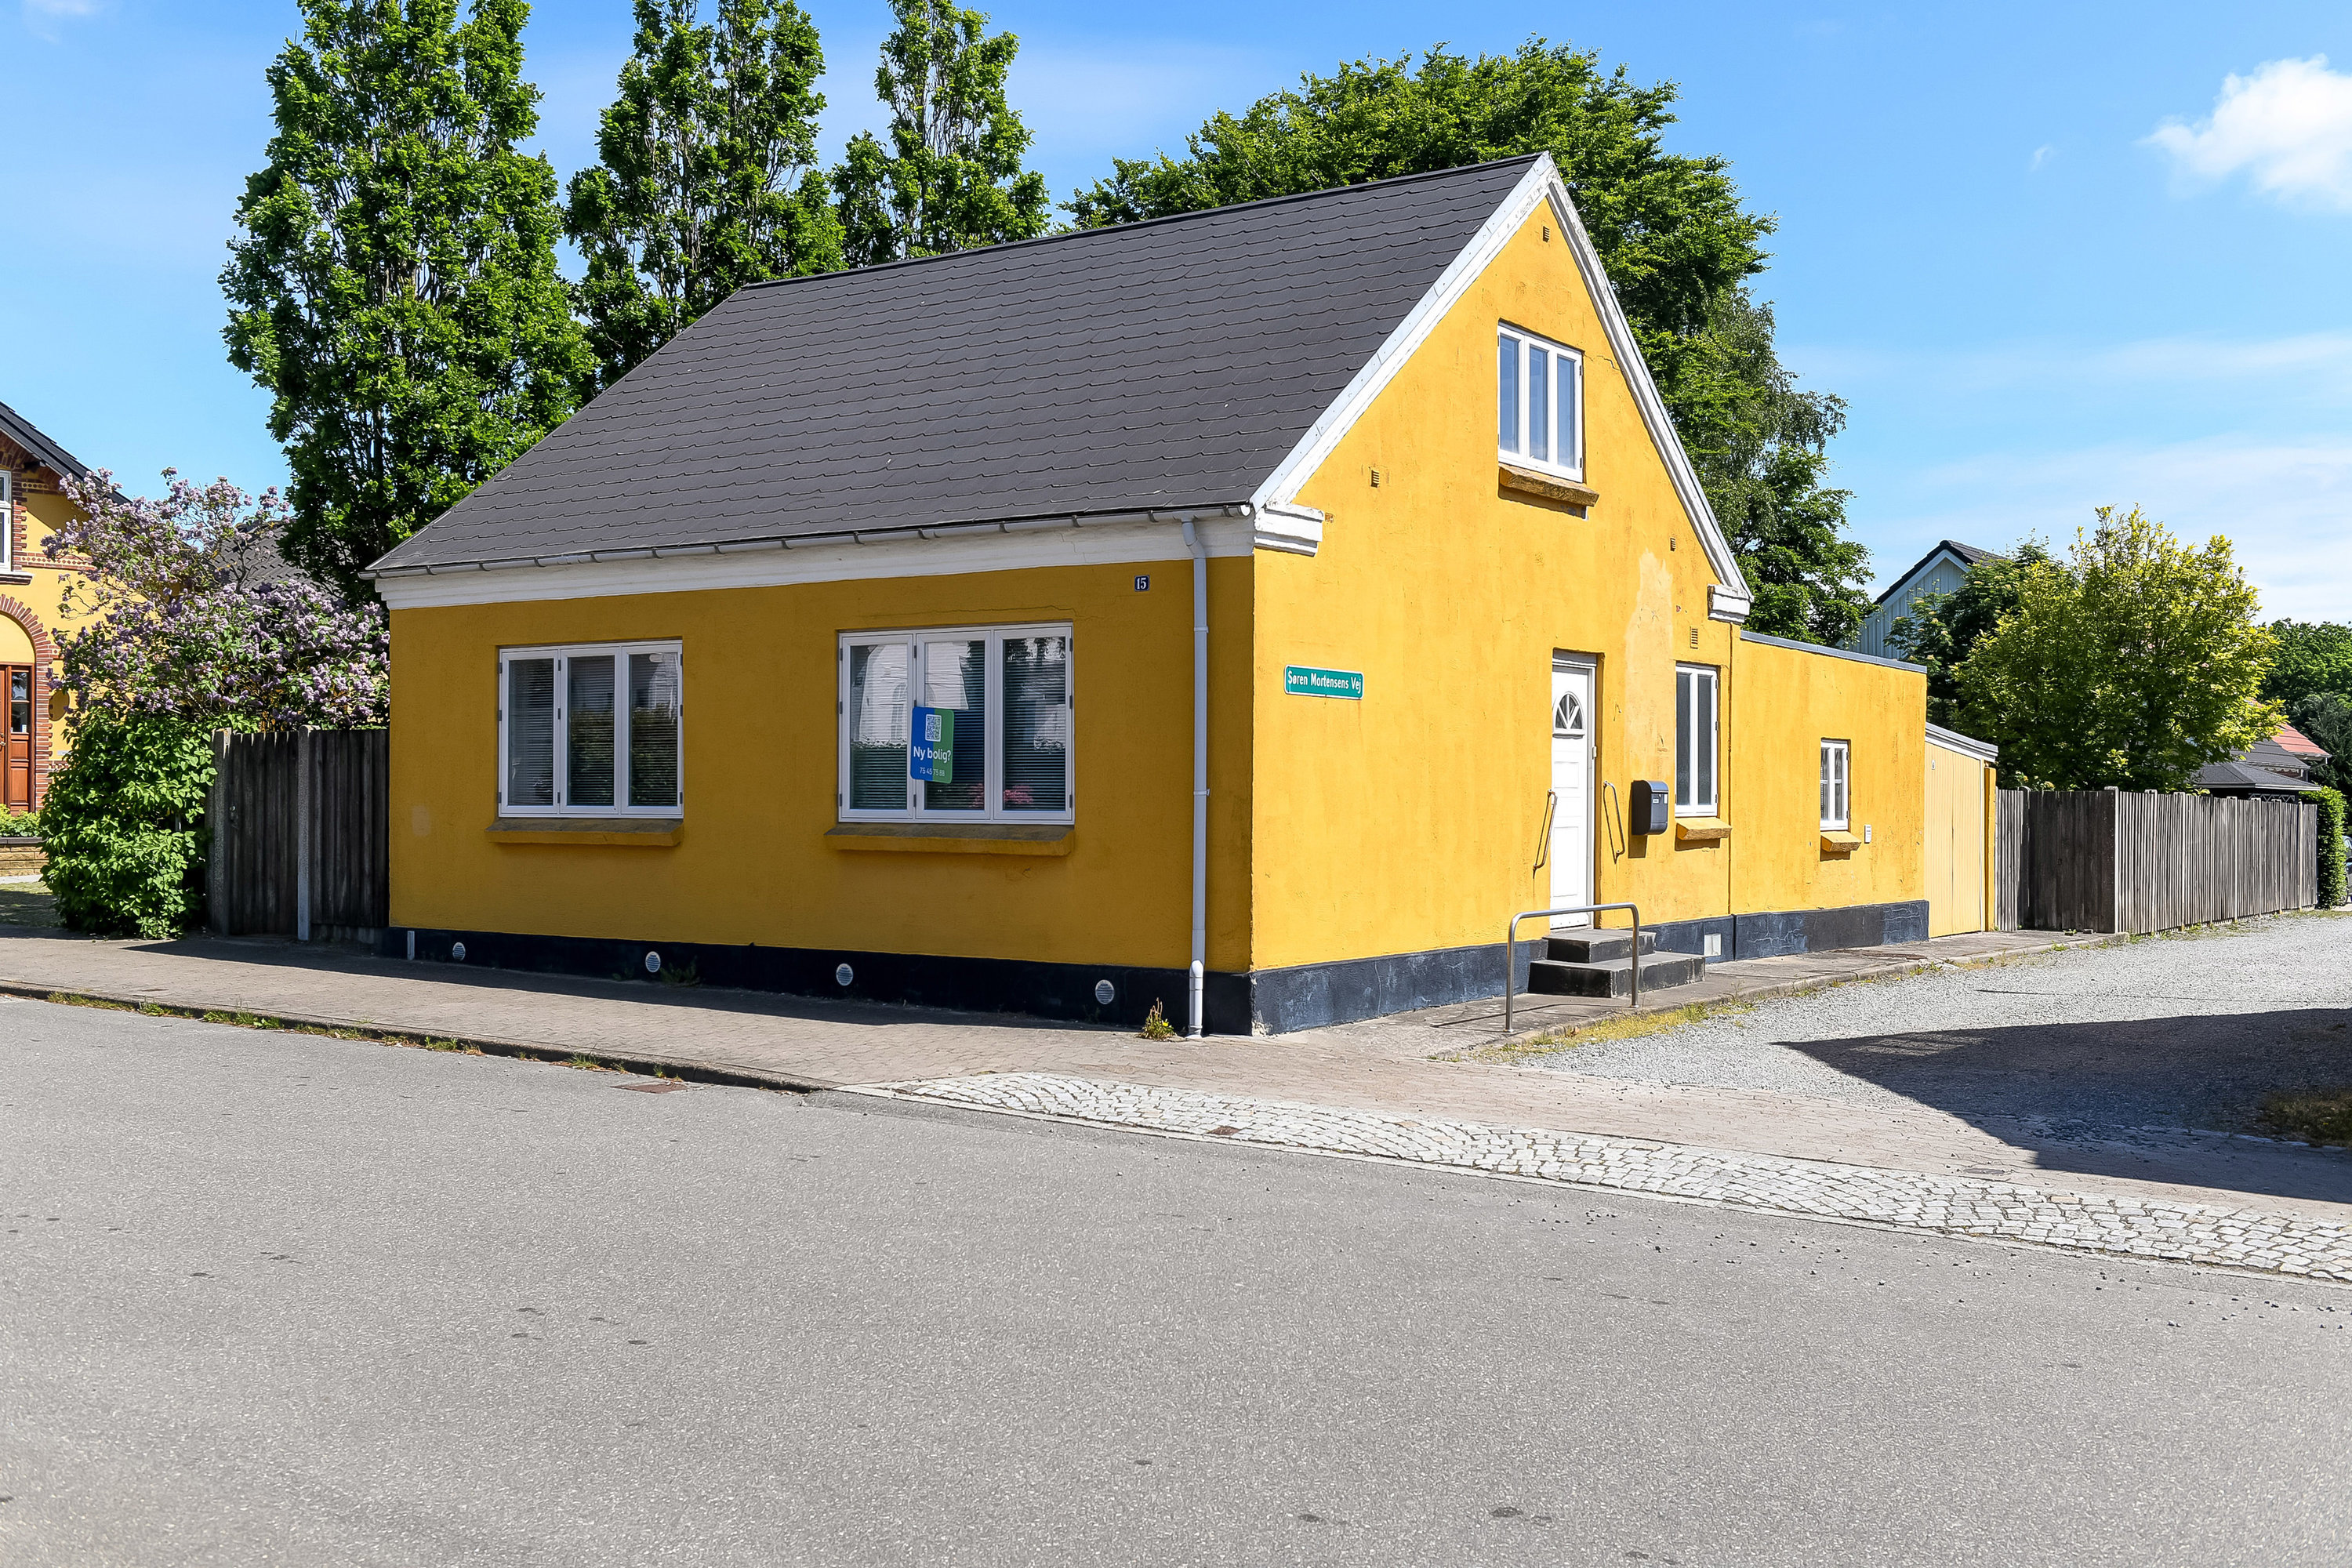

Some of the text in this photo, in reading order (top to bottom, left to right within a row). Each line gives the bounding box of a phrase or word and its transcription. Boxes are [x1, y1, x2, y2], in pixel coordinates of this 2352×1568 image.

[1137, 577, 1147, 590] 15
[1288, 670, 1362, 694] Søren Mortensens Vej
[913, 746, 951, 764] Ny bolig?
